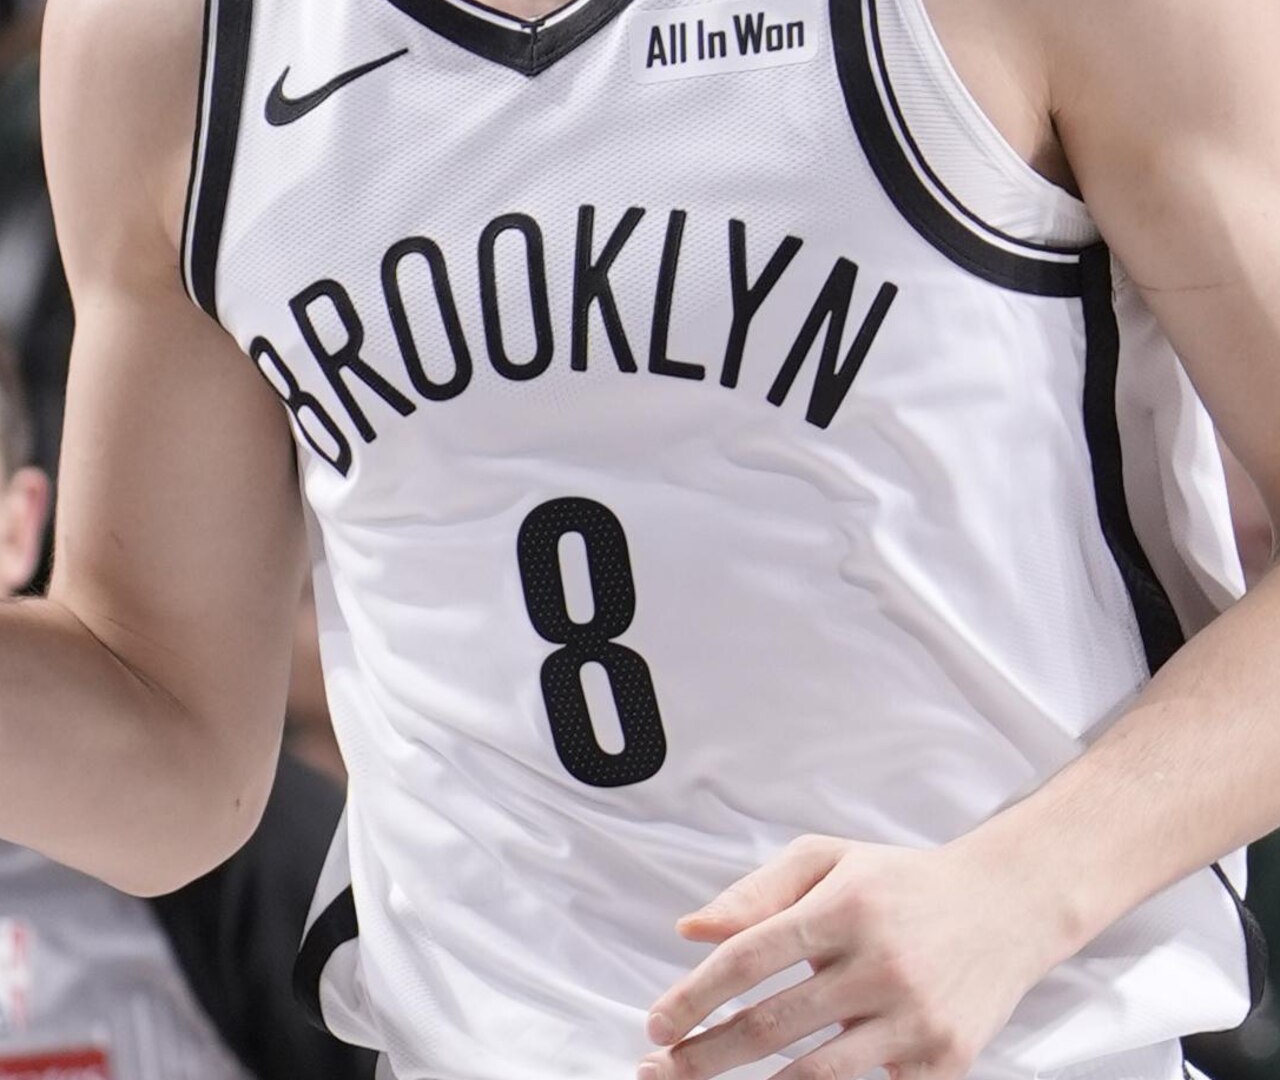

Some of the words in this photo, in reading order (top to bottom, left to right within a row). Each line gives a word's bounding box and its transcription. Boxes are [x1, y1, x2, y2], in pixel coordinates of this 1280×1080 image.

[646, 22, 687, 68] All
[697, 19, 727, 61] In
[732, 11, 805, 56] Won
[249, 204, 898, 478] BROOKLYN
[517, 496, 667, 788] 8
